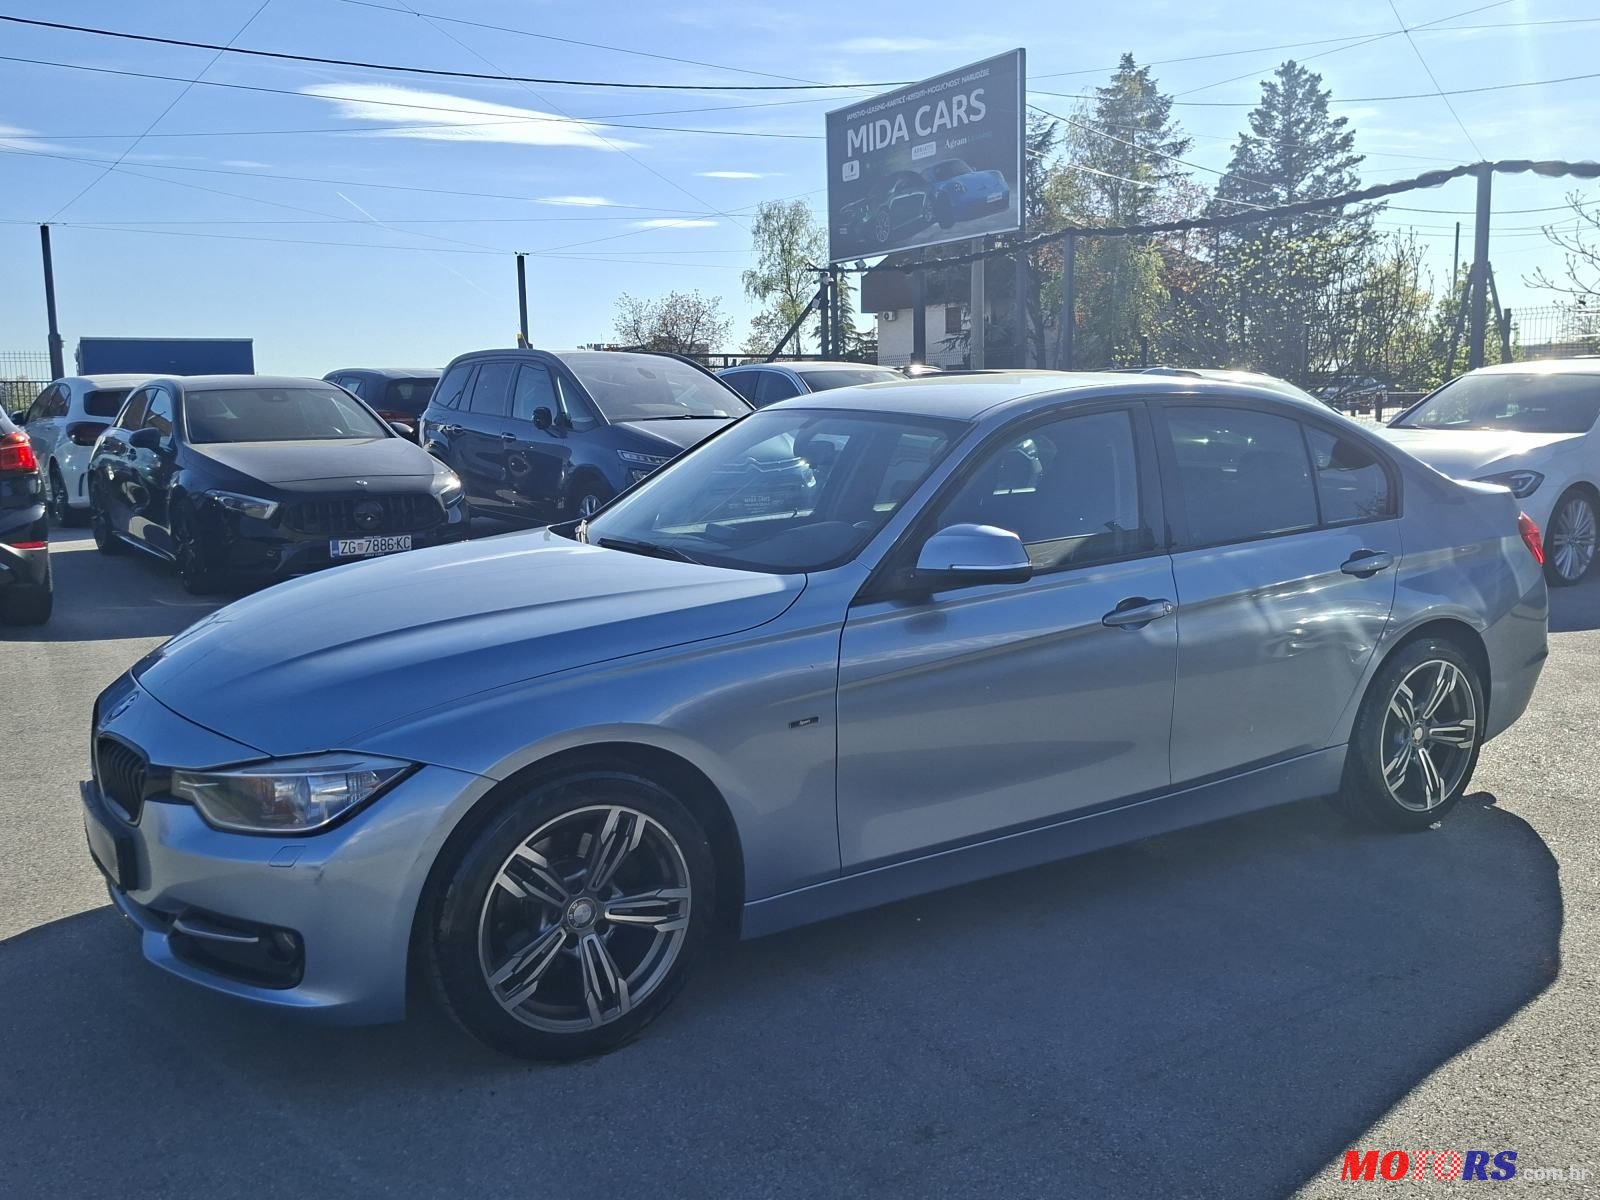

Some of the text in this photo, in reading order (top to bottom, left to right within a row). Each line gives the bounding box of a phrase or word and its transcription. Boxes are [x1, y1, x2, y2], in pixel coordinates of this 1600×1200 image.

[847, 88, 986, 157] MIDA CARS
[340, 541, 356, 554] ZG
